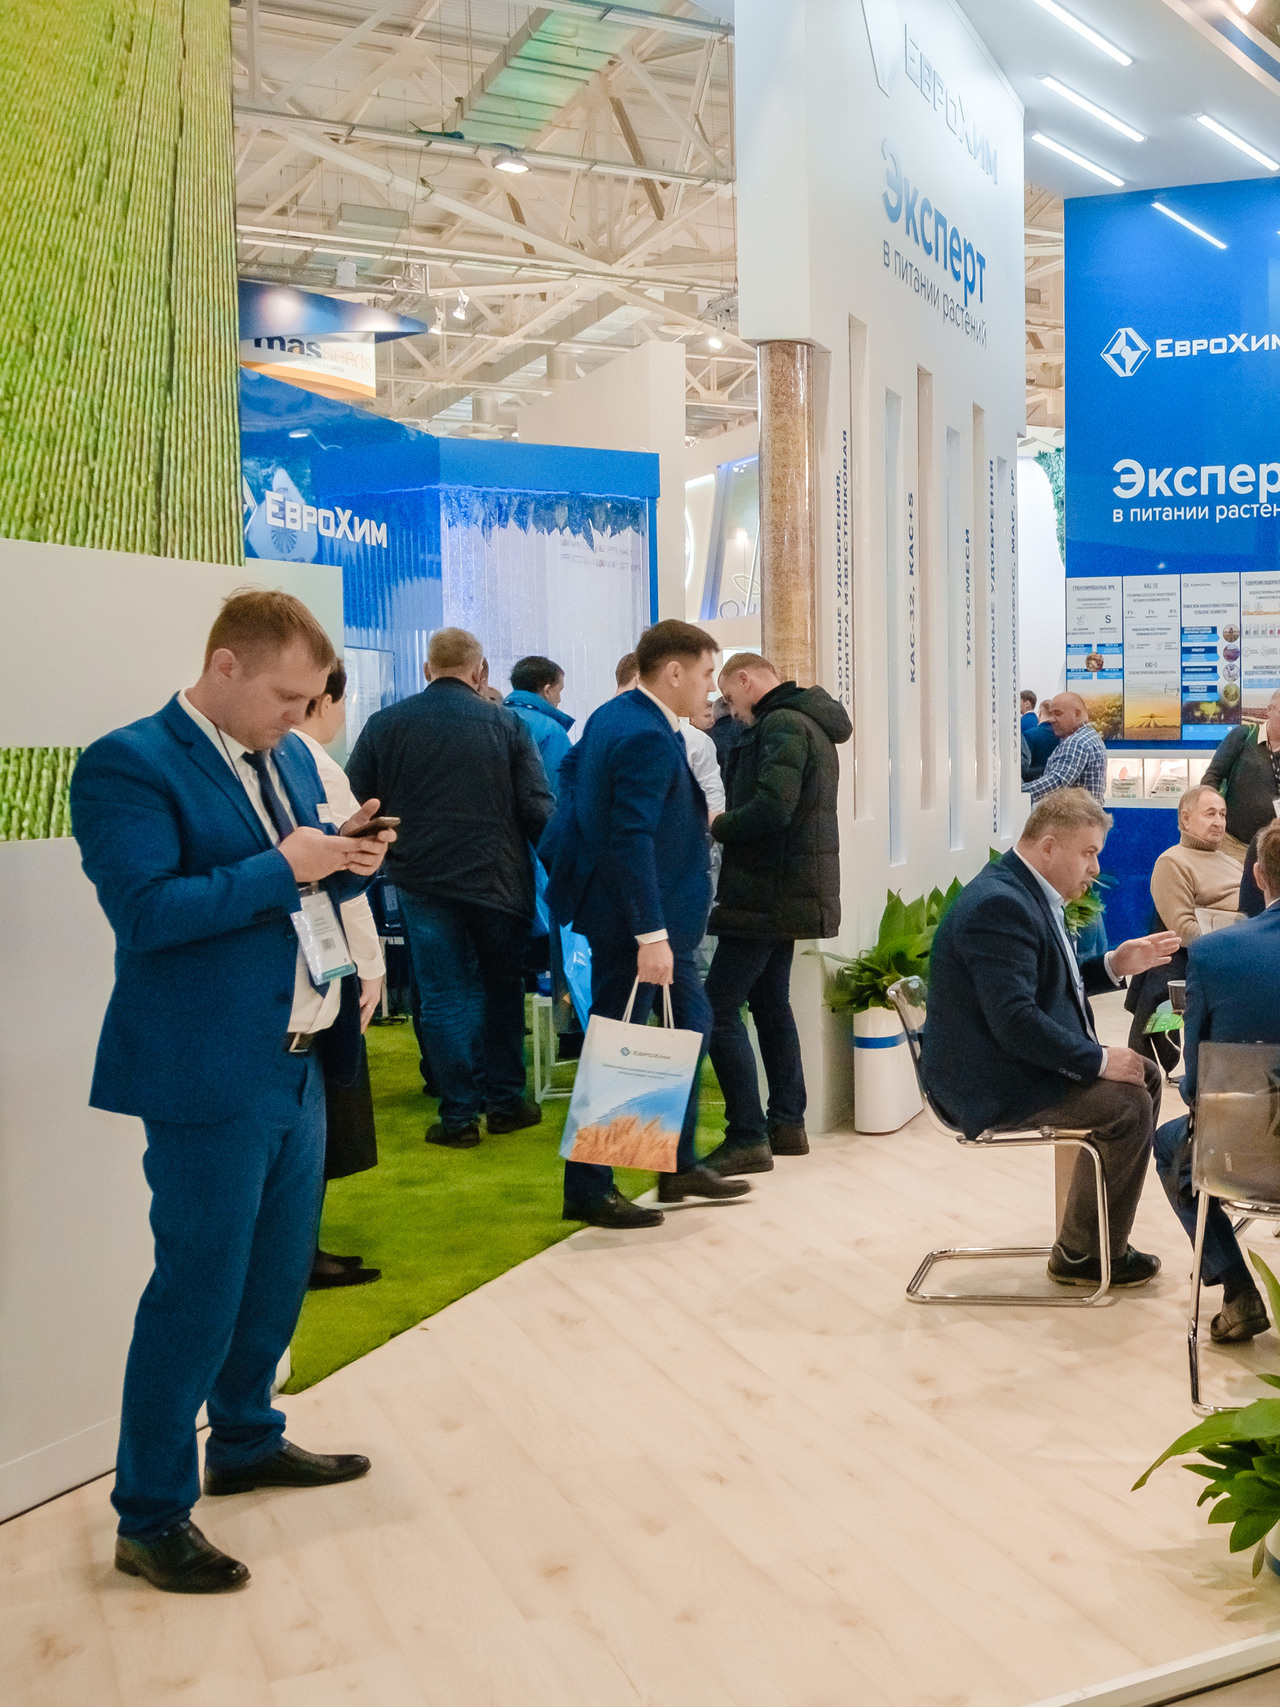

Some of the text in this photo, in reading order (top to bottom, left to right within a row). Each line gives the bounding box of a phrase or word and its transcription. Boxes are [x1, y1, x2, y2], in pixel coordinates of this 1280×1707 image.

[881, 137, 986, 307] Эксперт
[883, 239, 987, 350] в питании растений
[265, 490, 388, 549] ЕвроХим
[1112, 509, 1123, 522] в
[1130, 505, 1209, 522] питании
[1105, 615, 1112, 624] S
